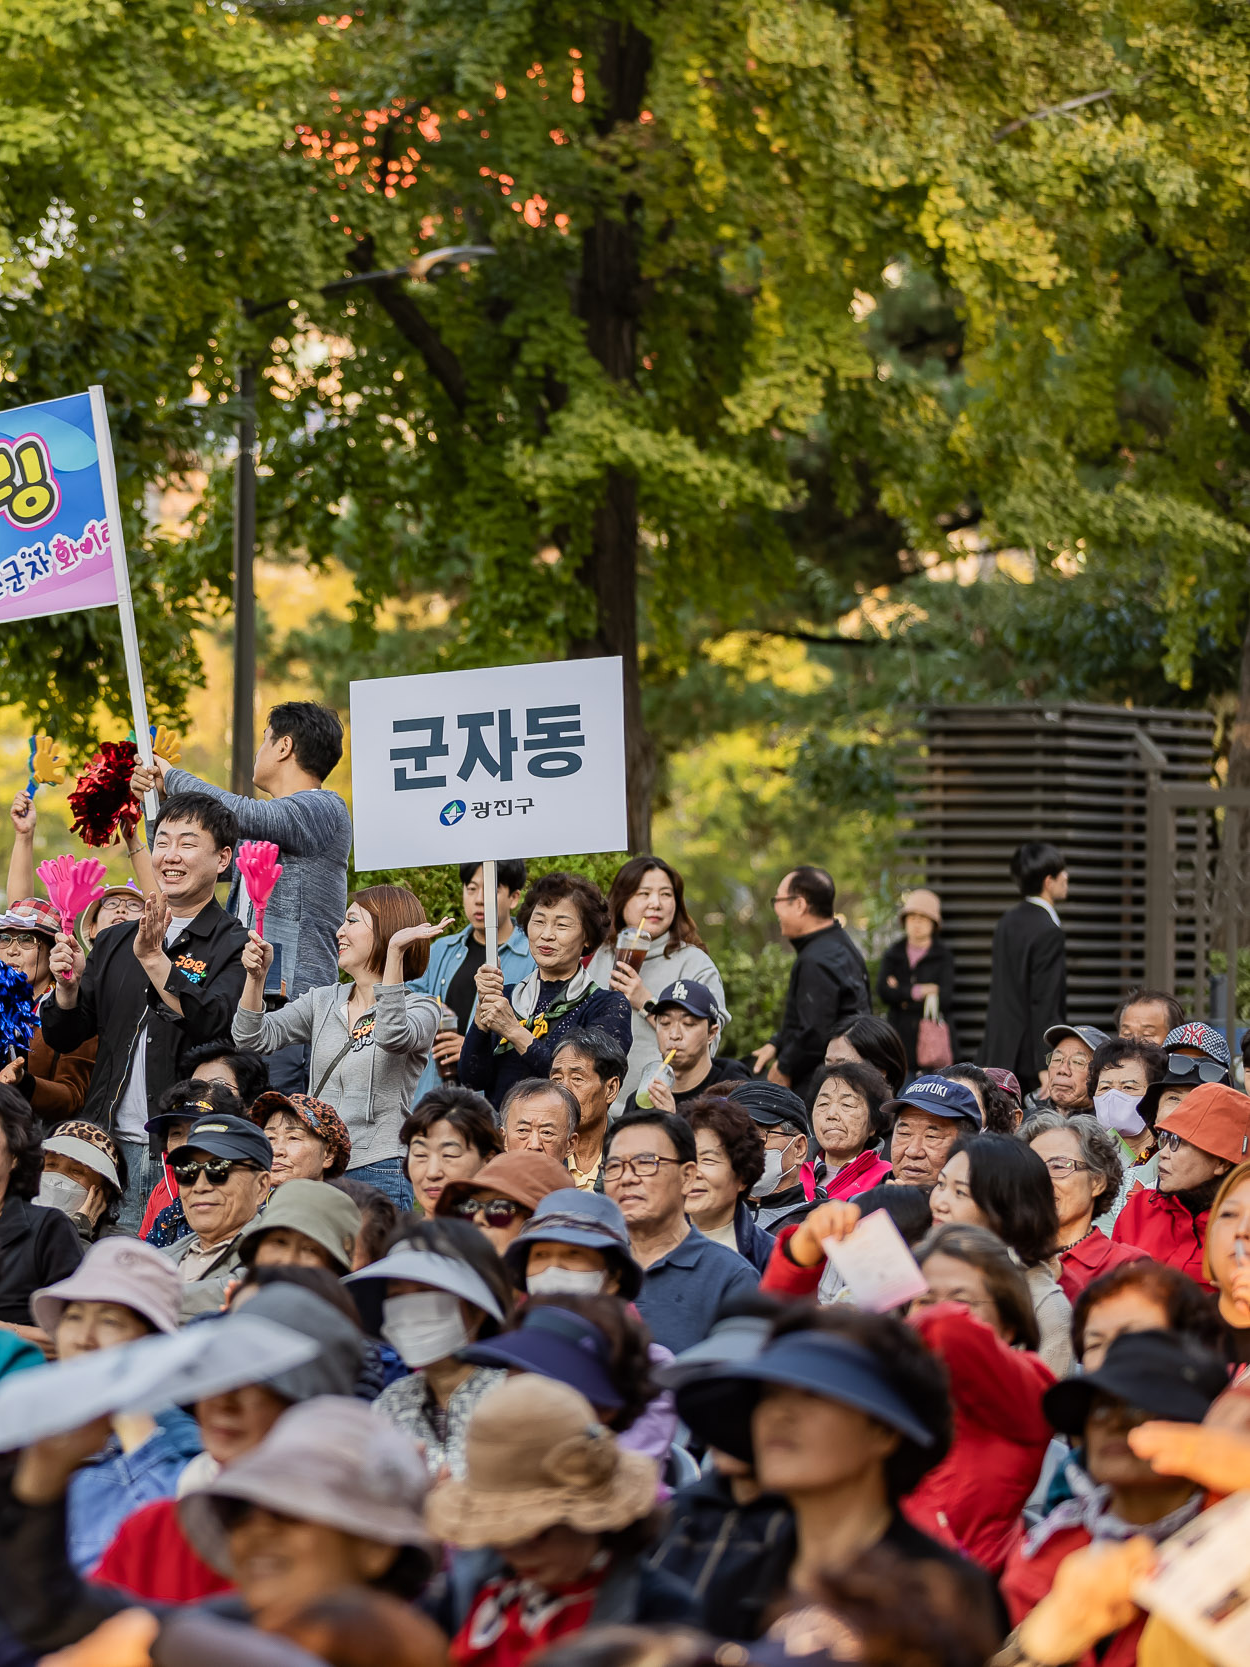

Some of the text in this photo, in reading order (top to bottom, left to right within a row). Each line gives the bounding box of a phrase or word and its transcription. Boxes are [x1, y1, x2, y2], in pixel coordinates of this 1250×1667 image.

[389, 704, 586, 792] 군자동
[470, 797, 535, 820] 광진구
[175, 954, 207, 974] 구의원
[672, 980, 689, 1000] LA
